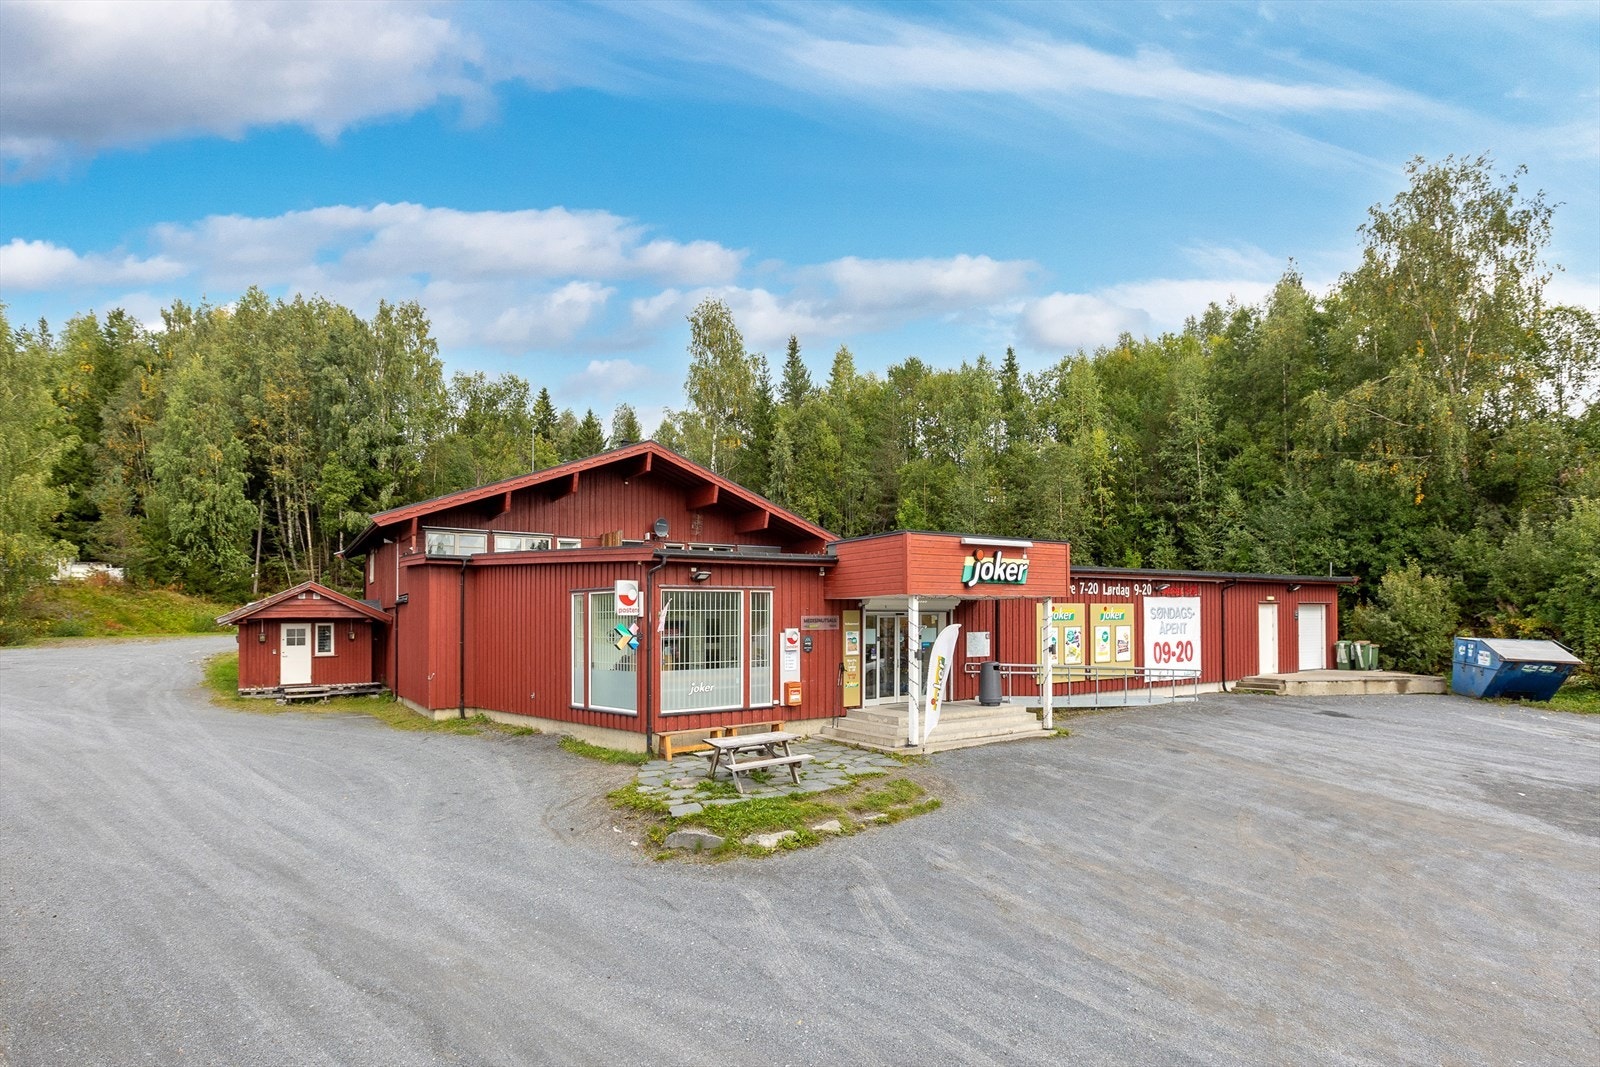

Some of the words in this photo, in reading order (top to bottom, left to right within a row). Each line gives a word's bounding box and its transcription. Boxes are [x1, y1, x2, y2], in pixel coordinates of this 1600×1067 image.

[967, 549, 1028, 587] joker
[1080, 582, 1099, 595] 7-20
[1102, 583, 1130, 598] Lørdag
[1134, 583, 1152, 596] 9-20
[1101, 606, 1124, 622] joker
[1159, 621, 1187, 635] ÅPENT
[688, 681, 715, 696] joker
